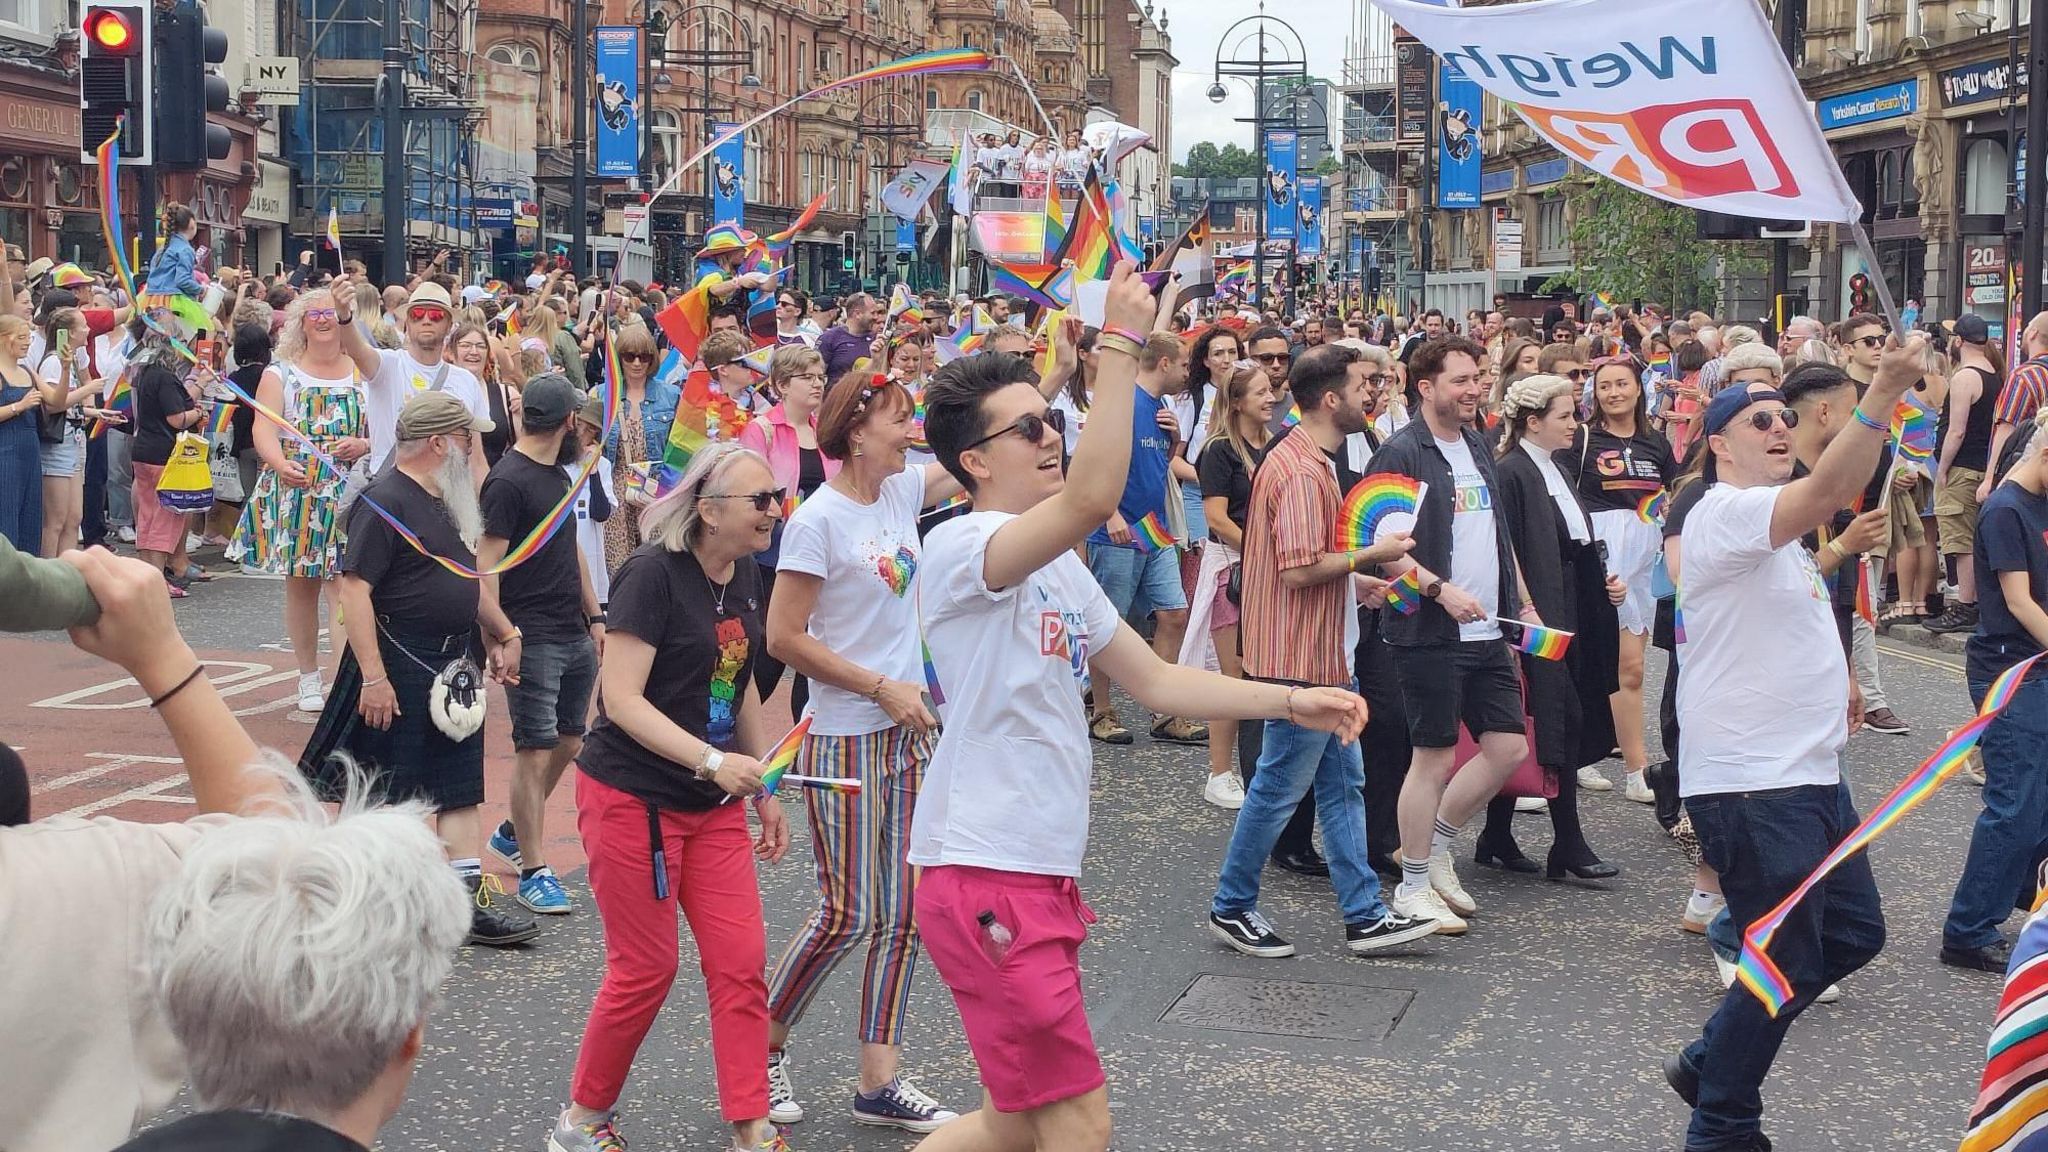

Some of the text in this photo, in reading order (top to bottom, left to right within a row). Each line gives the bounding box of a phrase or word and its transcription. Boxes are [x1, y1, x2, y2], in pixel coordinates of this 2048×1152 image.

[260, 66, 287, 79] NY
[8, 102, 68, 135] GENERAL
[1831, 95, 1901, 121] Yorkshire Cancer Research
[1970, 247, 1995, 267] 20
